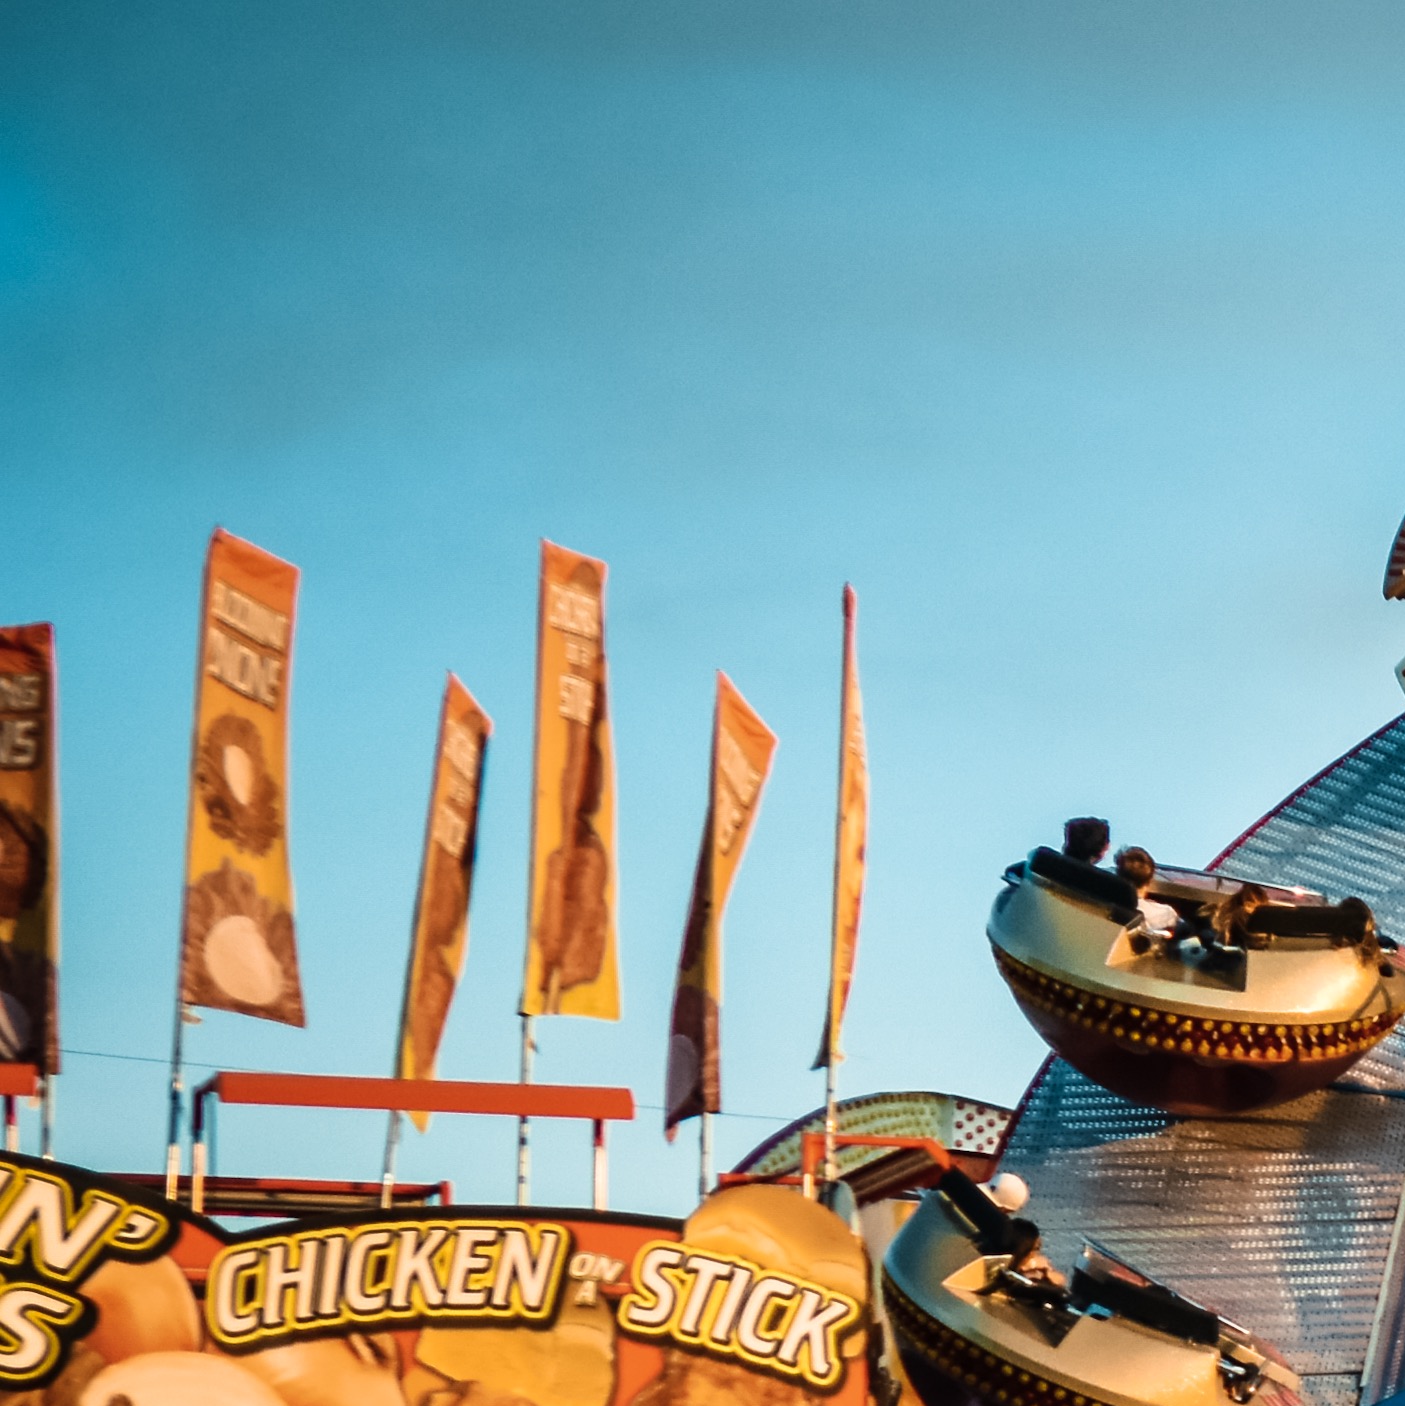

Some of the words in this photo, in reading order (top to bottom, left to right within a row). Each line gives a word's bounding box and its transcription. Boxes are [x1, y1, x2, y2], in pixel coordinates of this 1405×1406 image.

[213, 1227, 561, 1336] CHICKEN
[570, 1252, 625, 1285] ON
[574, 1279, 598, 1306] A
[0, 1286, 75, 1370] S
[626, 1246, 853, 1377] STICK
